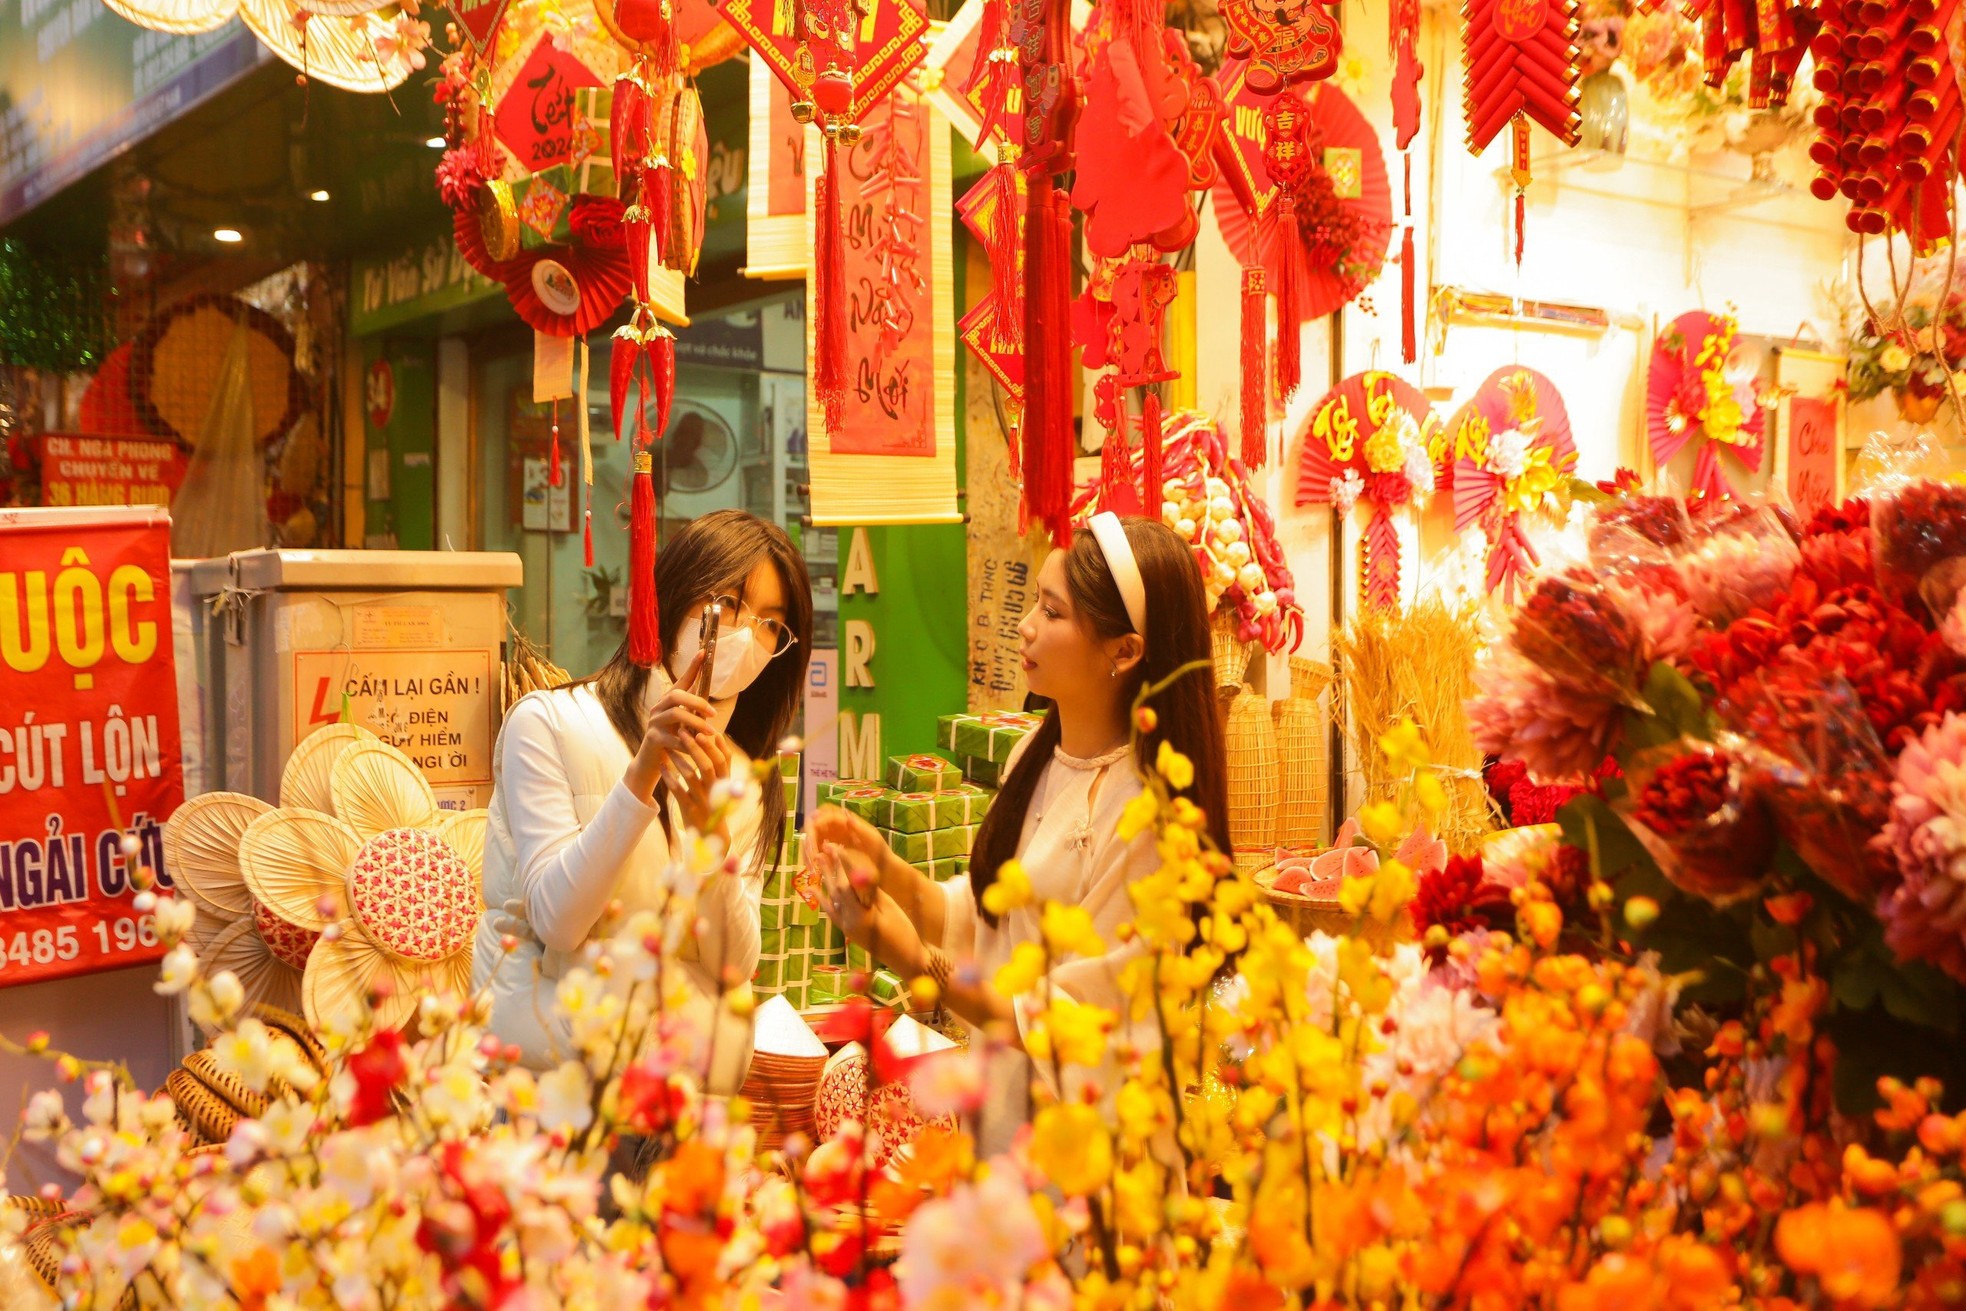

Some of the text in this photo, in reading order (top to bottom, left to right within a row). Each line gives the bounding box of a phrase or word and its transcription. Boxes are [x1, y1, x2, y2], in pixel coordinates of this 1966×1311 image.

[527, 63, 576, 135] Tết
[1276, 110, 1296, 161] 吉祥
[117, 441, 172, 461] PHONG
[0, 547, 158, 690] UỘC
[345, 671, 388, 698] CẤM
[394, 678, 423, 701] LẠI
[429, 670, 469, 696] GẦN
[409, 708, 449, 727] ĐIỆN
[79, 704, 162, 797] LỘN
[379, 727, 462, 748] GUY HIỂM
[460, 800, 466, 811] 2
